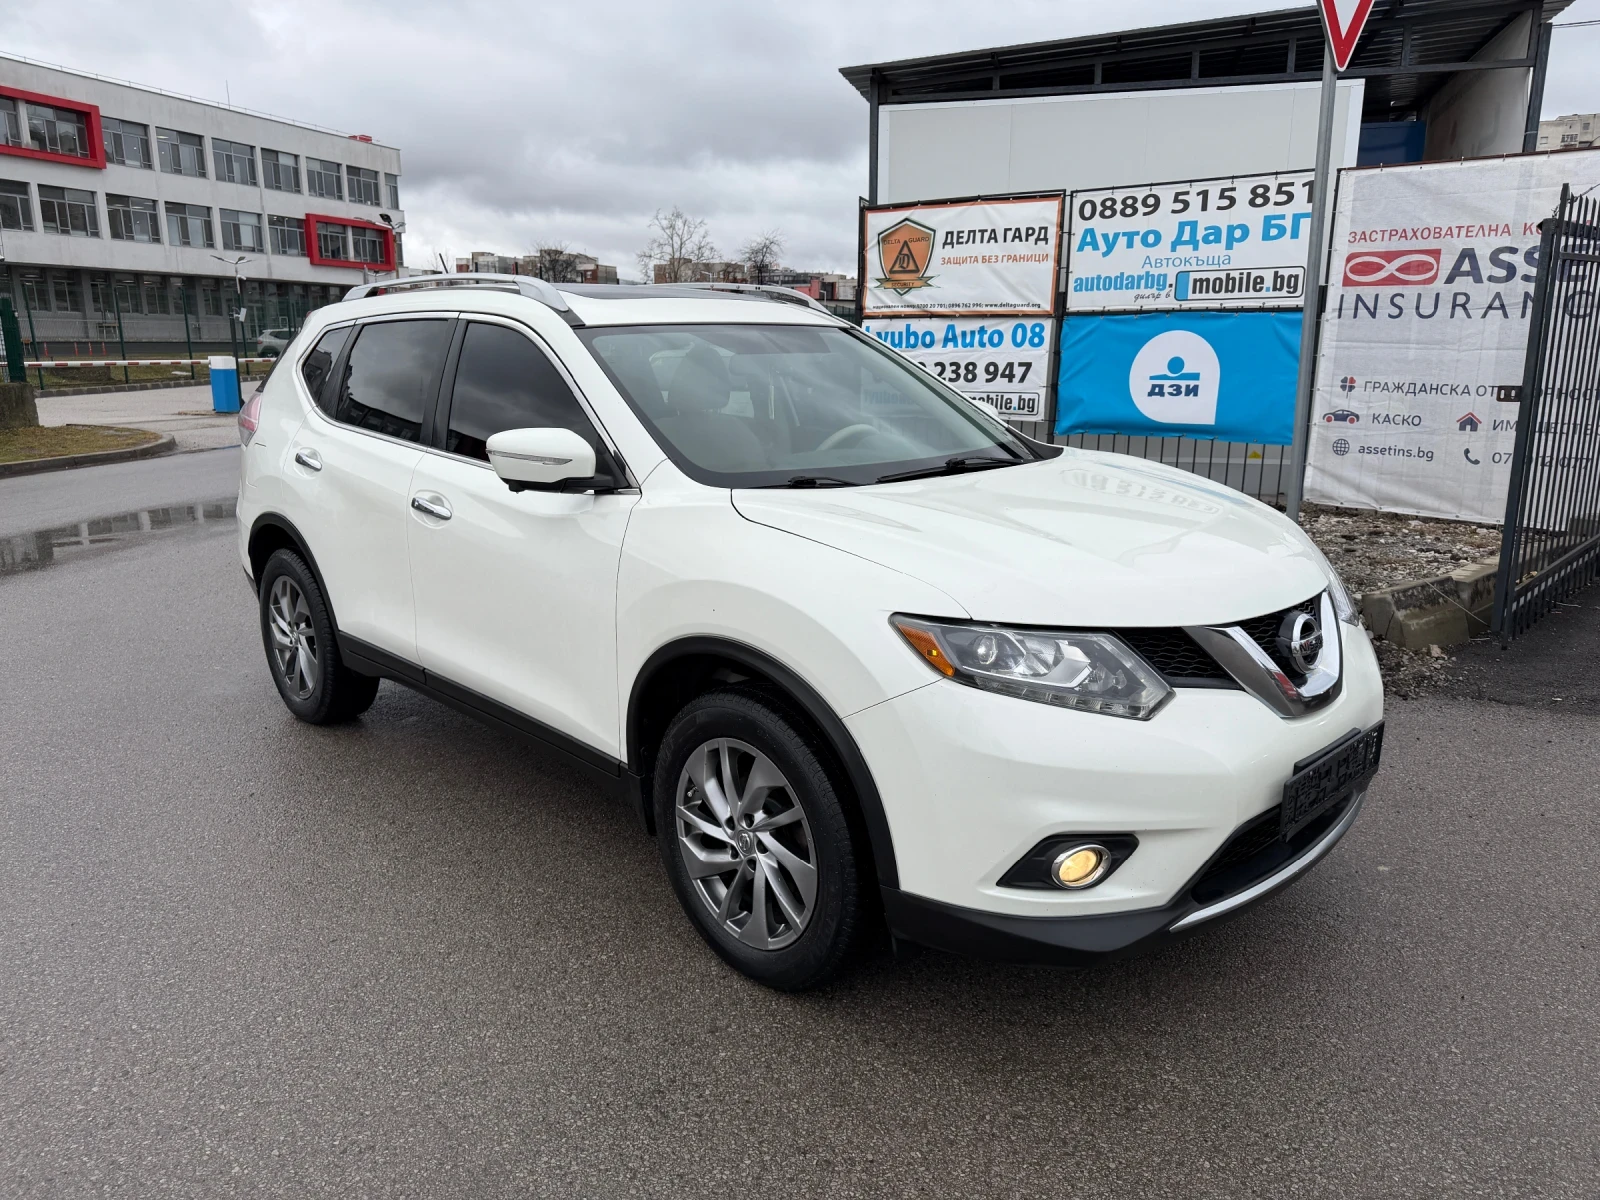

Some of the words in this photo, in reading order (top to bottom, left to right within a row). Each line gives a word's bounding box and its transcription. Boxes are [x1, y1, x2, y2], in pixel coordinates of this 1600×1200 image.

[1078, 193, 1161, 221] 0889
[1170, 187, 1237, 214] 515
[1248, 180, 1314, 208] 851
[883, 238, 901, 246] DELTA
[908, 236, 930, 244] GUARD
[942, 228, 999, 249] ДЕЛТА
[1002, 226, 1049, 245] ГАРД
[1076, 227, 1163, 258] Ауто
[1170, 220, 1250, 252] Дар
[1261, 212, 1312, 241] БГ
[1347, 223, 1512, 244] ЗАСТРАХОВАТЕЛНА
[940, 255, 979, 267] ЗАЩИТА
[981, 254, 999, 264] БЕЗ
[1001, 253, 1049, 265] ГРАНИЦИ
[1141, 254, 1231, 269] Автокъща
[1191, 270, 1300, 295] mobile.bg
[865, 323, 936, 349] yubo
[941, 324, 1004, 349] Auto
[1011, 322, 1045, 348] 08
[933, 361, 978, 383] 238
[984, 361, 1033, 384] 947
[1147, 383, 1200, 398] ДЗИ
[1363, 380, 1471, 397] ГРАЖДАНСКА
[968, 394, 1036, 413] bile.bg
[1371, 412, 1422, 427] КАСКО
[1358, 445, 1434, 462] assetins.bg
